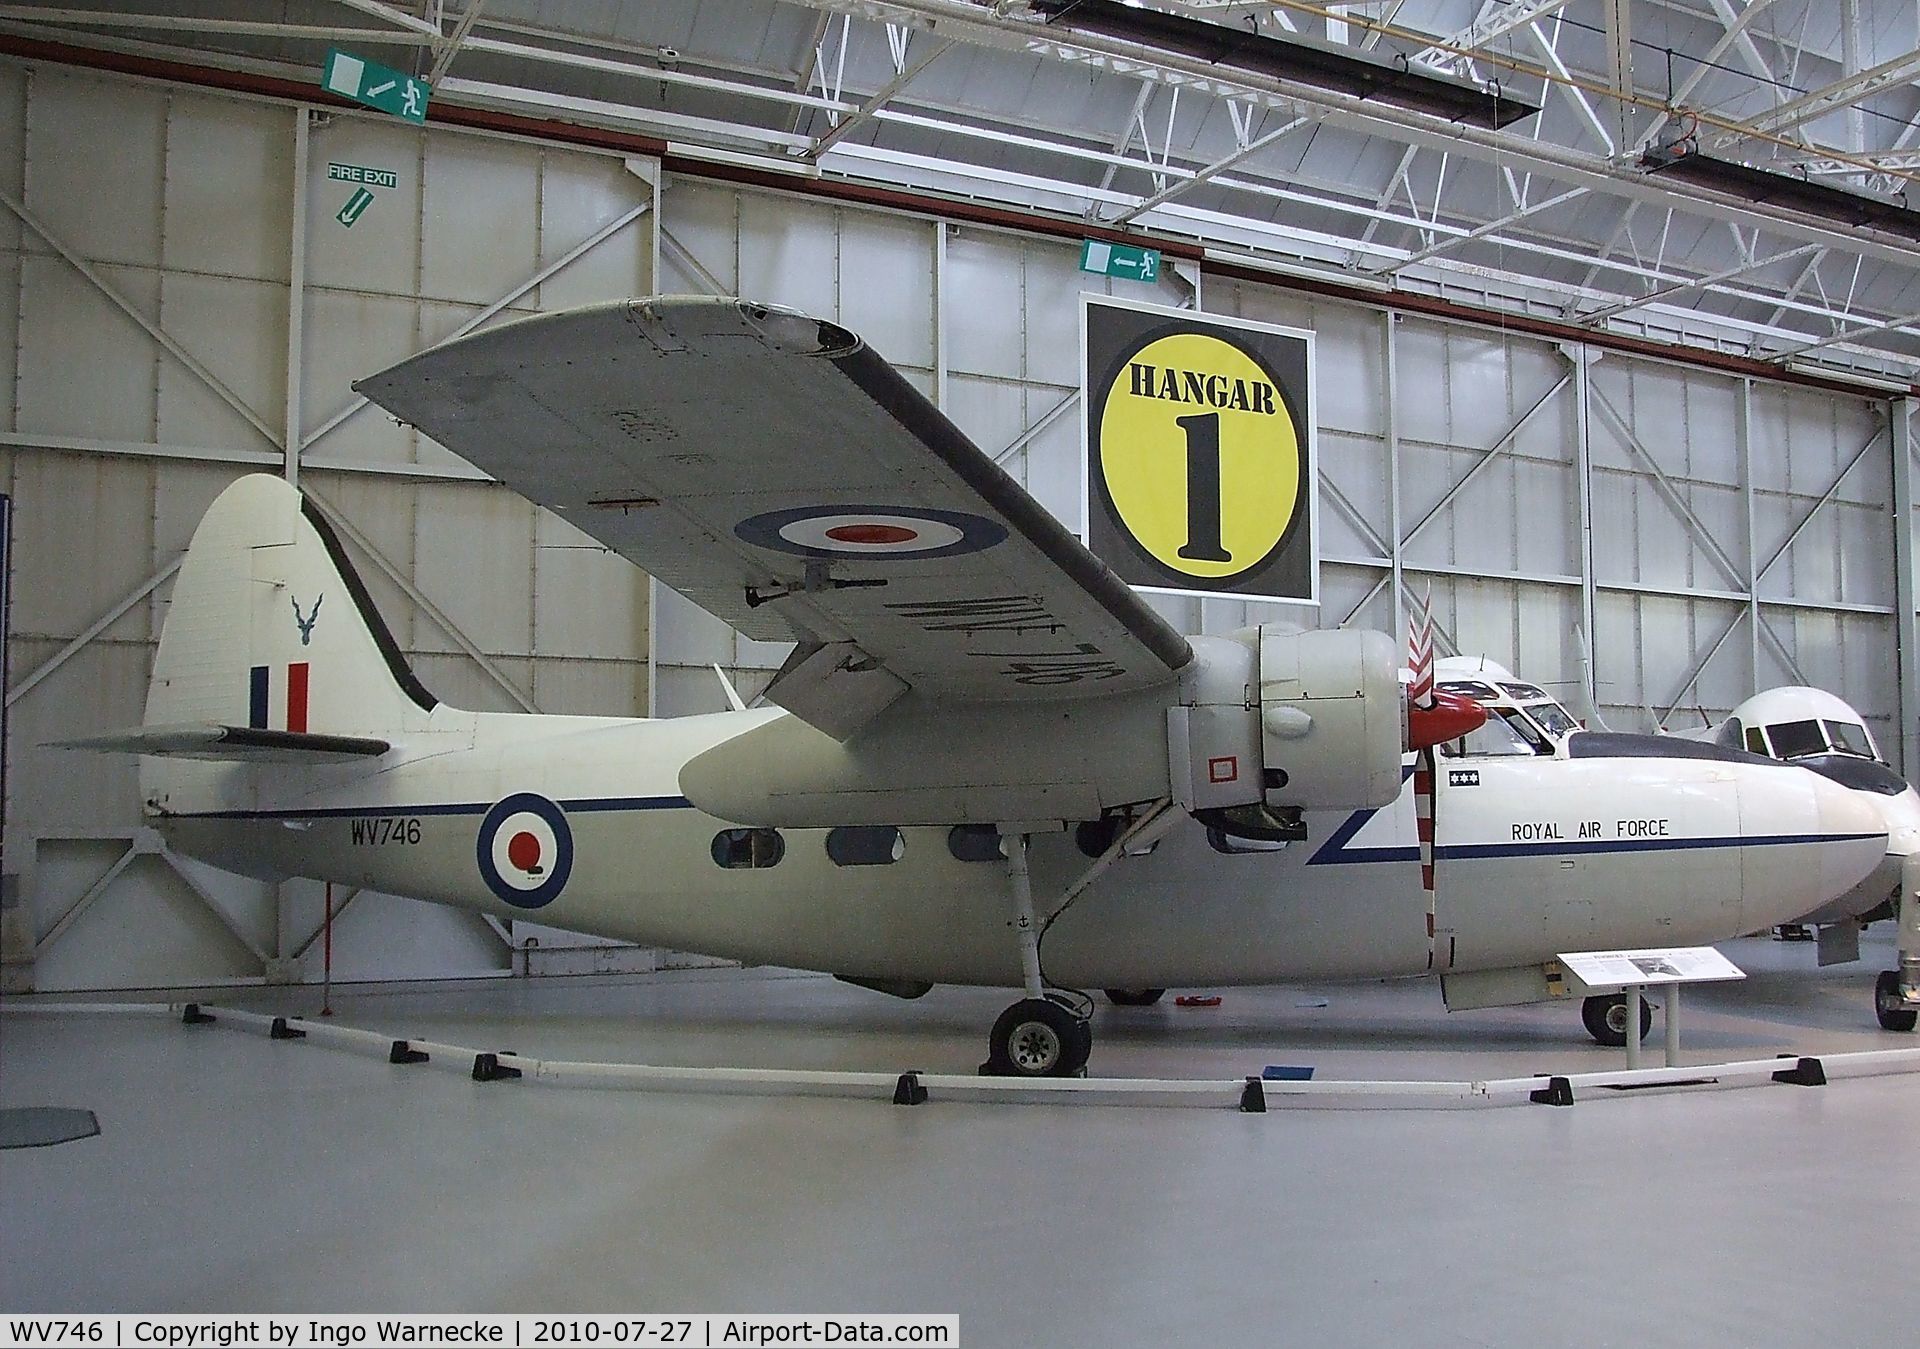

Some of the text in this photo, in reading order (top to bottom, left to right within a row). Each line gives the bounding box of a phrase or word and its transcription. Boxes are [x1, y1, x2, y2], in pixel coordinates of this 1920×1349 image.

[329, 165, 396, 186] FIRE EXIT
[1129, 362, 1276, 415] HANGAR
[1175, 411, 1232, 562] 1
[352, 818, 421, 845] WV746
[1511, 818, 1669, 841] ROYAL AIR FORCE
